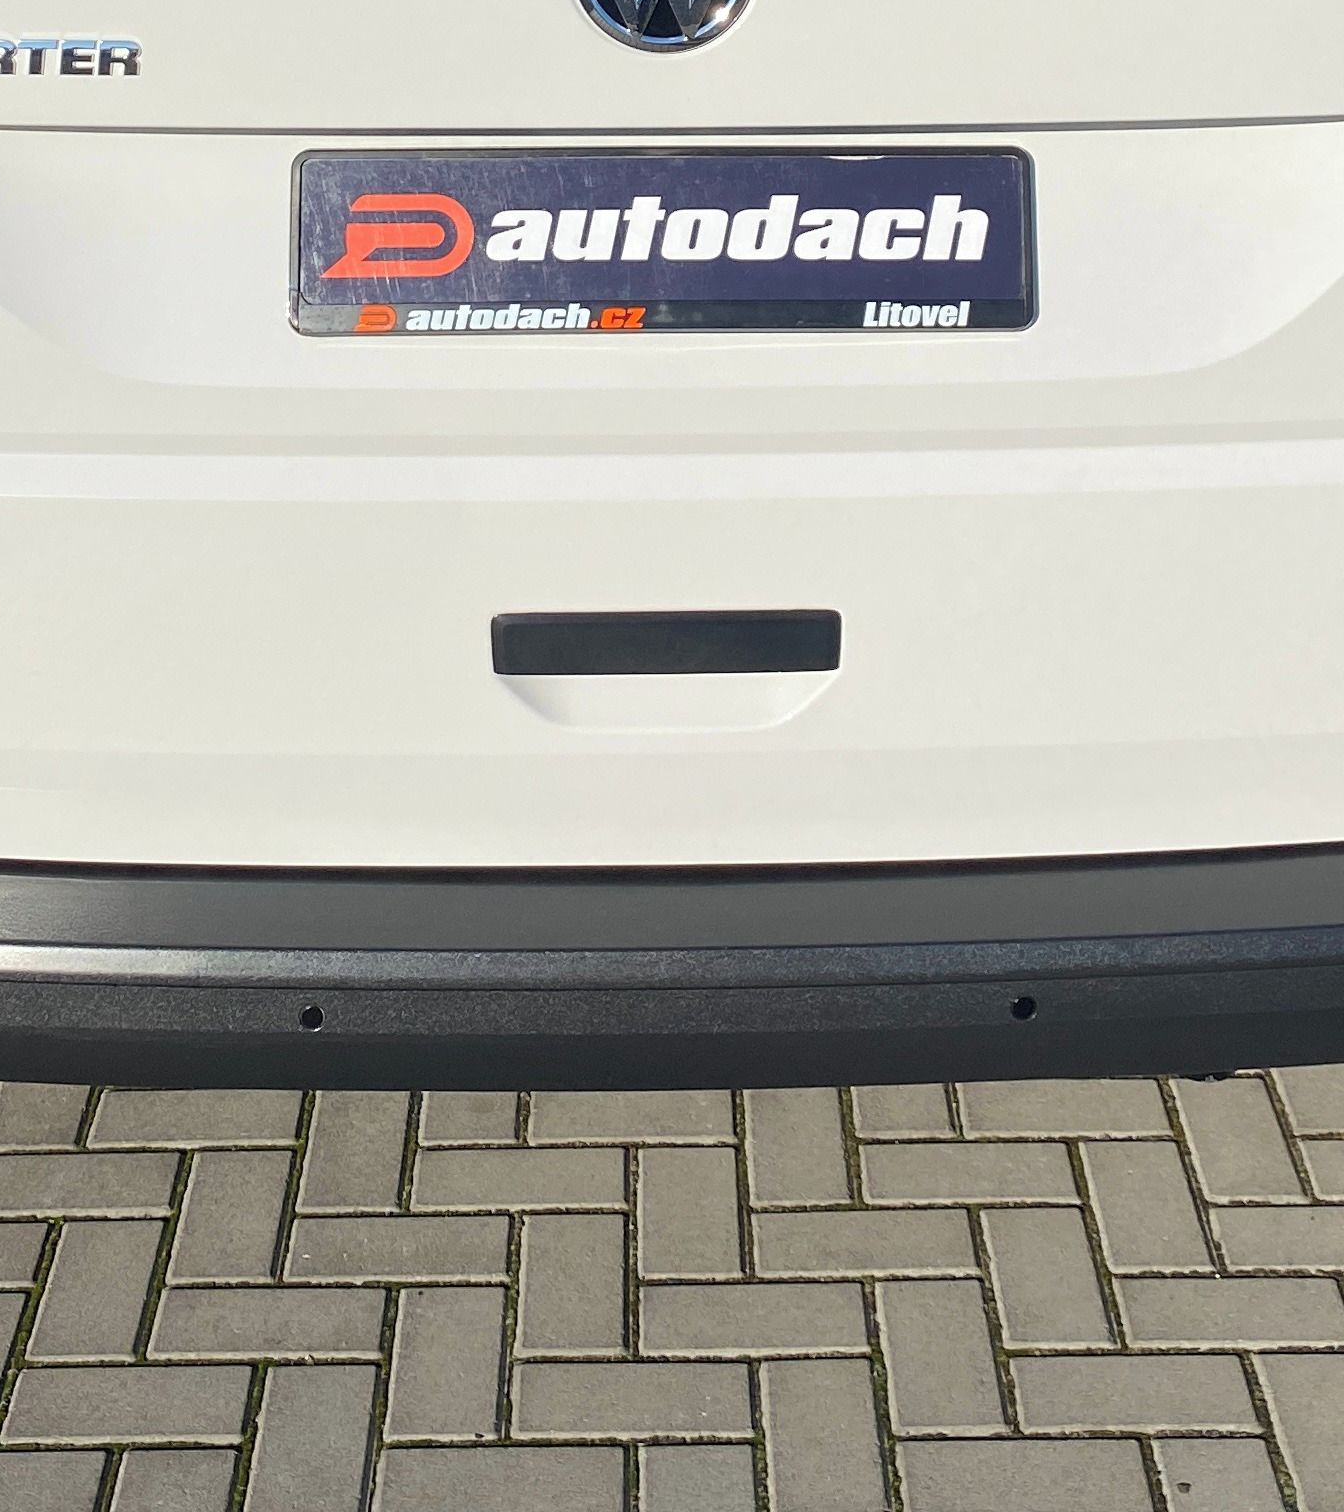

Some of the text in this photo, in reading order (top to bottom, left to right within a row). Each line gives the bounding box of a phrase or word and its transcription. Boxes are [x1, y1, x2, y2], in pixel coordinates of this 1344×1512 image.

[485, 193, 990, 262] autodach
[405, 302, 646, 331] autodach.cz
[863, 300, 970, 329] Litovel
